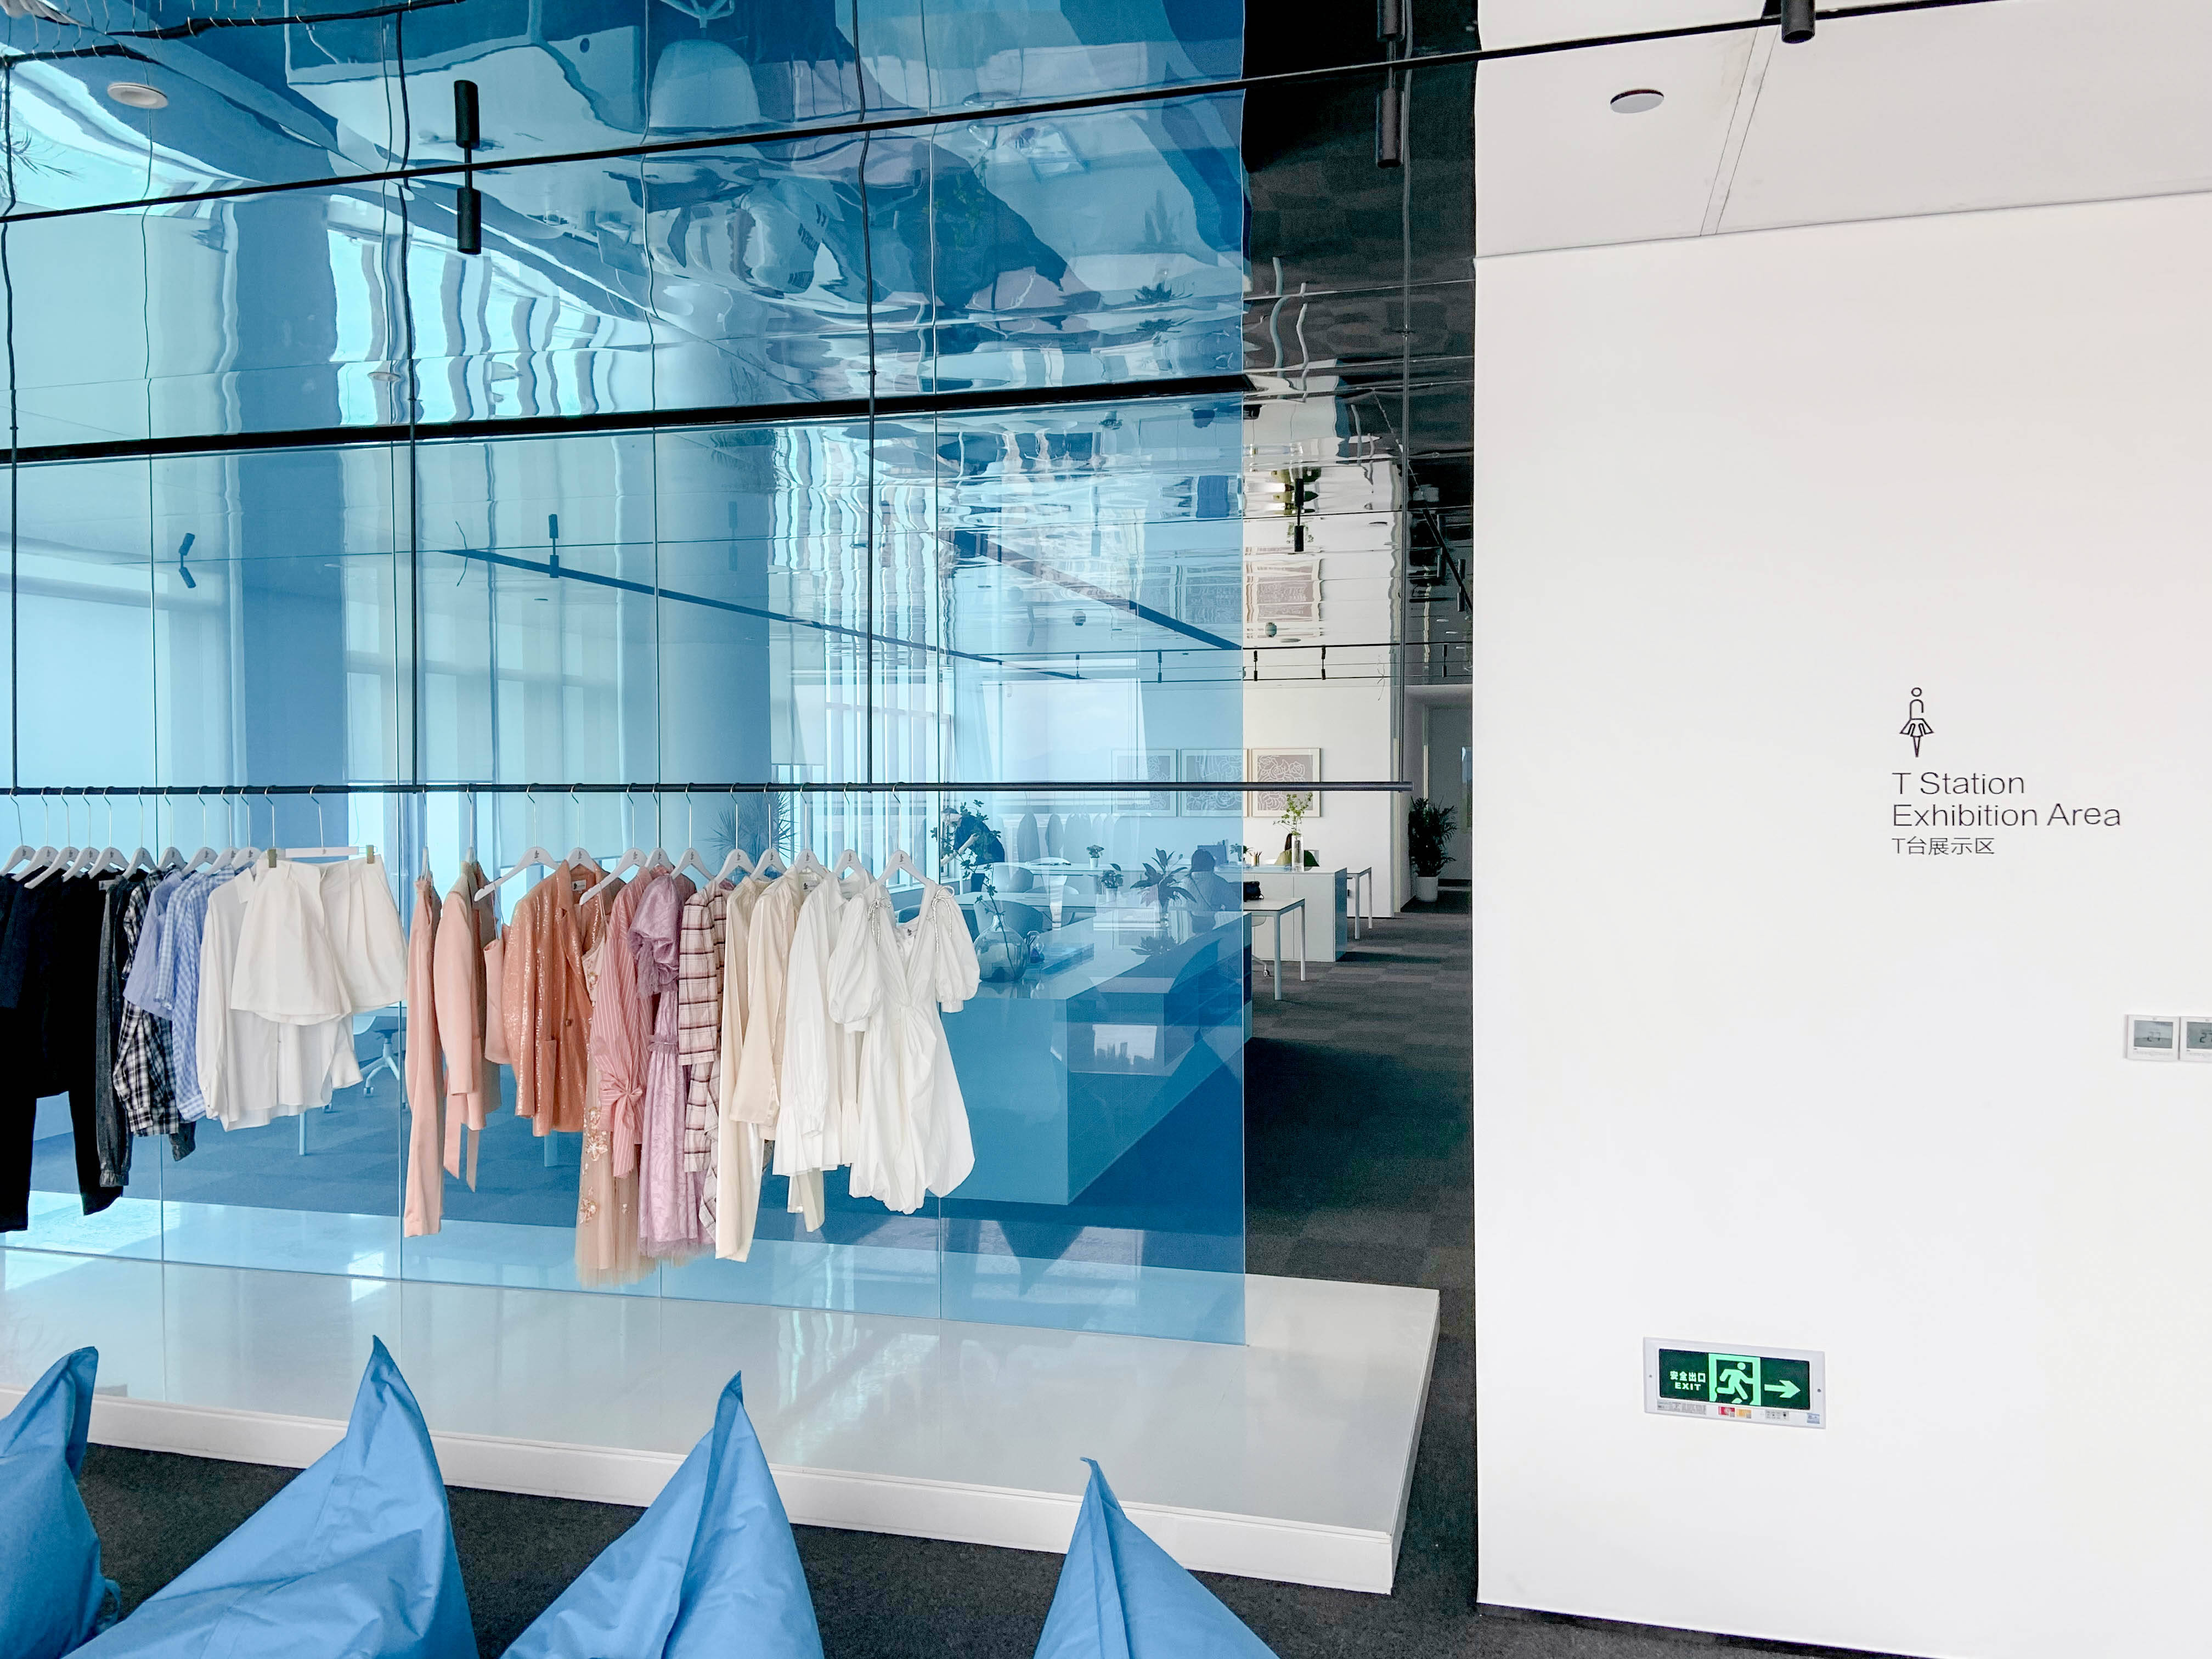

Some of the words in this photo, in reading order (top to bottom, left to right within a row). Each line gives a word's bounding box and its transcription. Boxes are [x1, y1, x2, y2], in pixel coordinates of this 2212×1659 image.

[1892, 772, 1912, 794] T
[1920, 771, 2025, 795] Station
[1893, 804, 2038, 827] Exhibition
[2047, 803, 2121, 827] Area
[1892, 836, 1995, 856] T台展示区
[1670, 1370, 1706, 1383] 安全出口
[1675, 1381, 1701, 1391] EXIT
